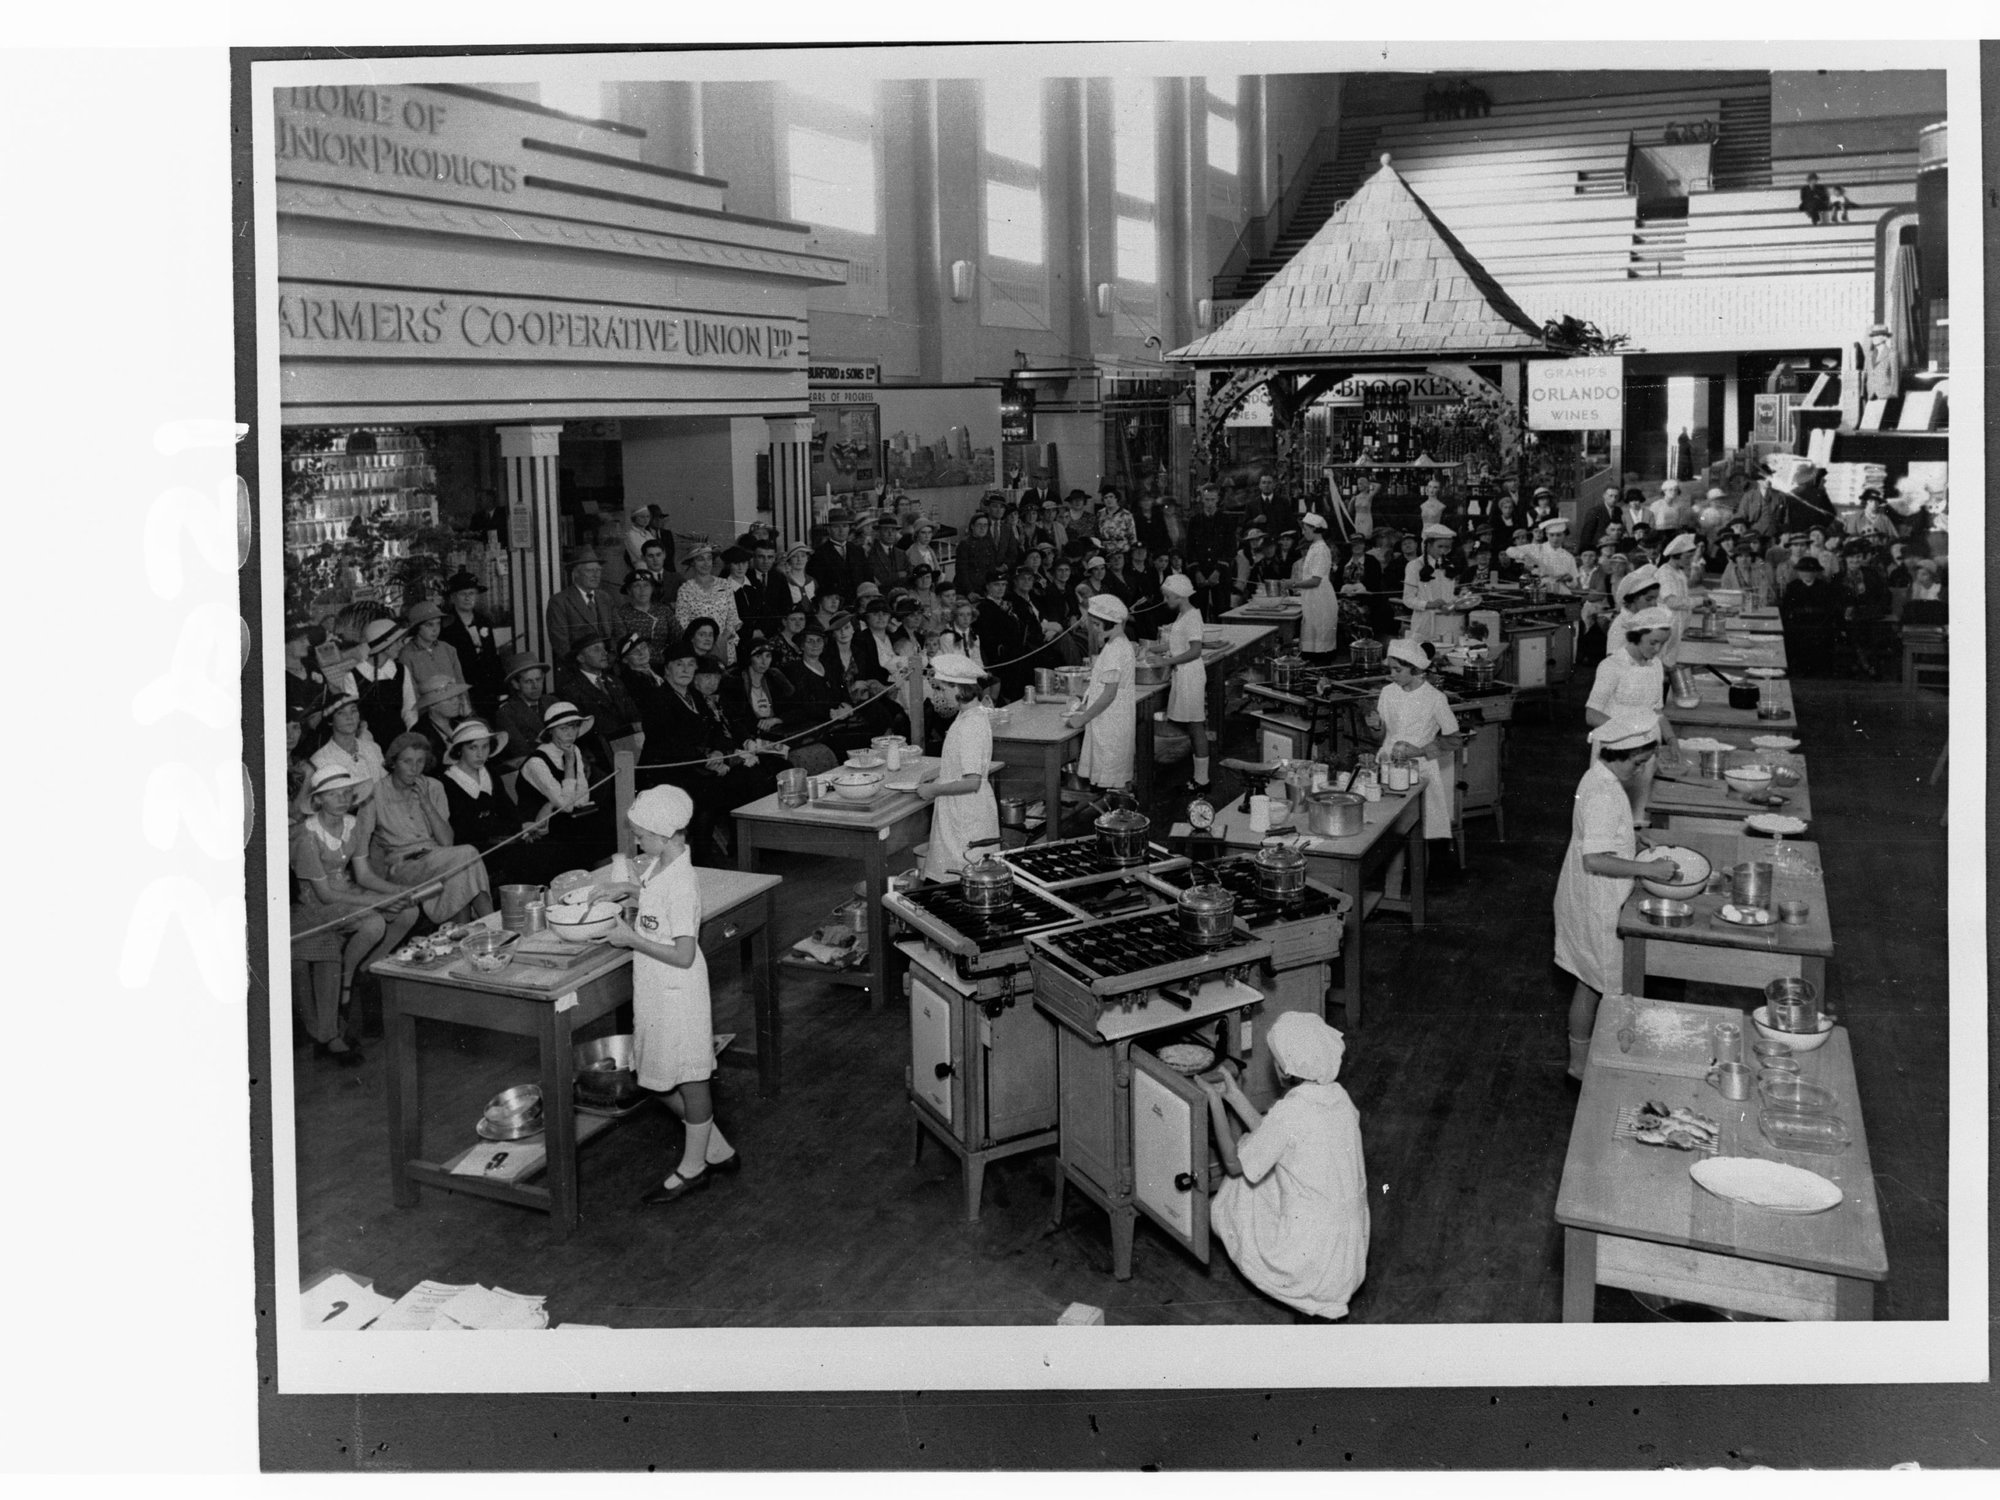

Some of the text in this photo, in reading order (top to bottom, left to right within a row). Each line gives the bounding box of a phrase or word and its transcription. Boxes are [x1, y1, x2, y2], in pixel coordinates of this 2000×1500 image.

[403, 101, 446, 135] OF
[372, 133, 517, 194] PRODUCTS
[683, 318, 762, 357] UNION
[831, 392, 840, 402] OF
[1532, 386, 1620, 402] ORLANDO
[1551, 409, 1600, 421] WINES
